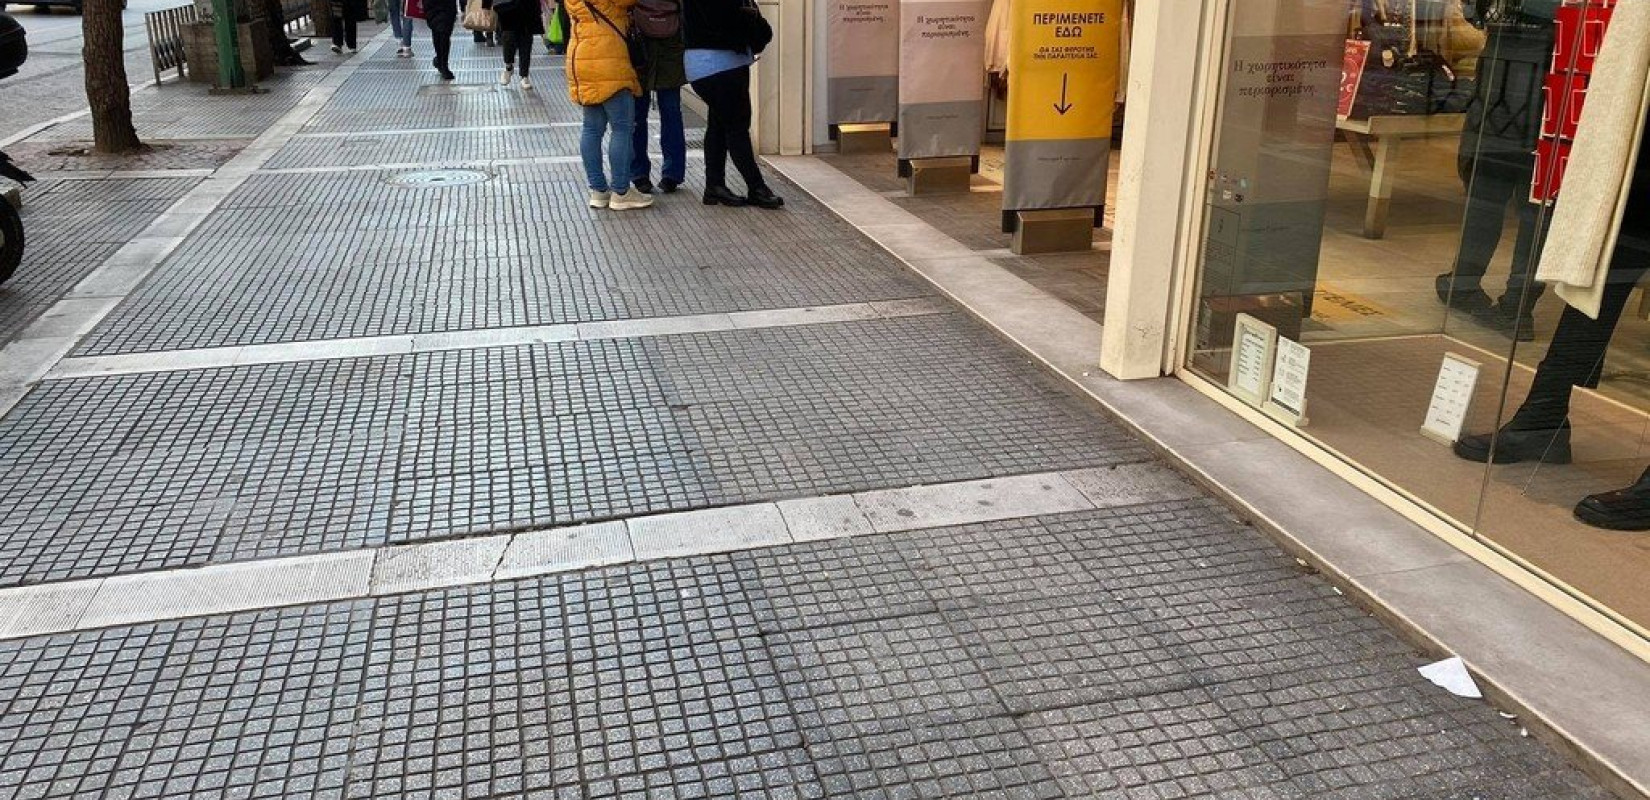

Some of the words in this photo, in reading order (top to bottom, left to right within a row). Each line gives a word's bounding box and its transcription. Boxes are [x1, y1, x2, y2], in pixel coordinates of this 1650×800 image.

[1033, 12, 1105, 25] ΠΕΡΙΜΕΝΕΤΕ
[1055, 25, 1082, 38] ΕΔΩ
[1247, 60, 1327, 74] χωρητικότητα
